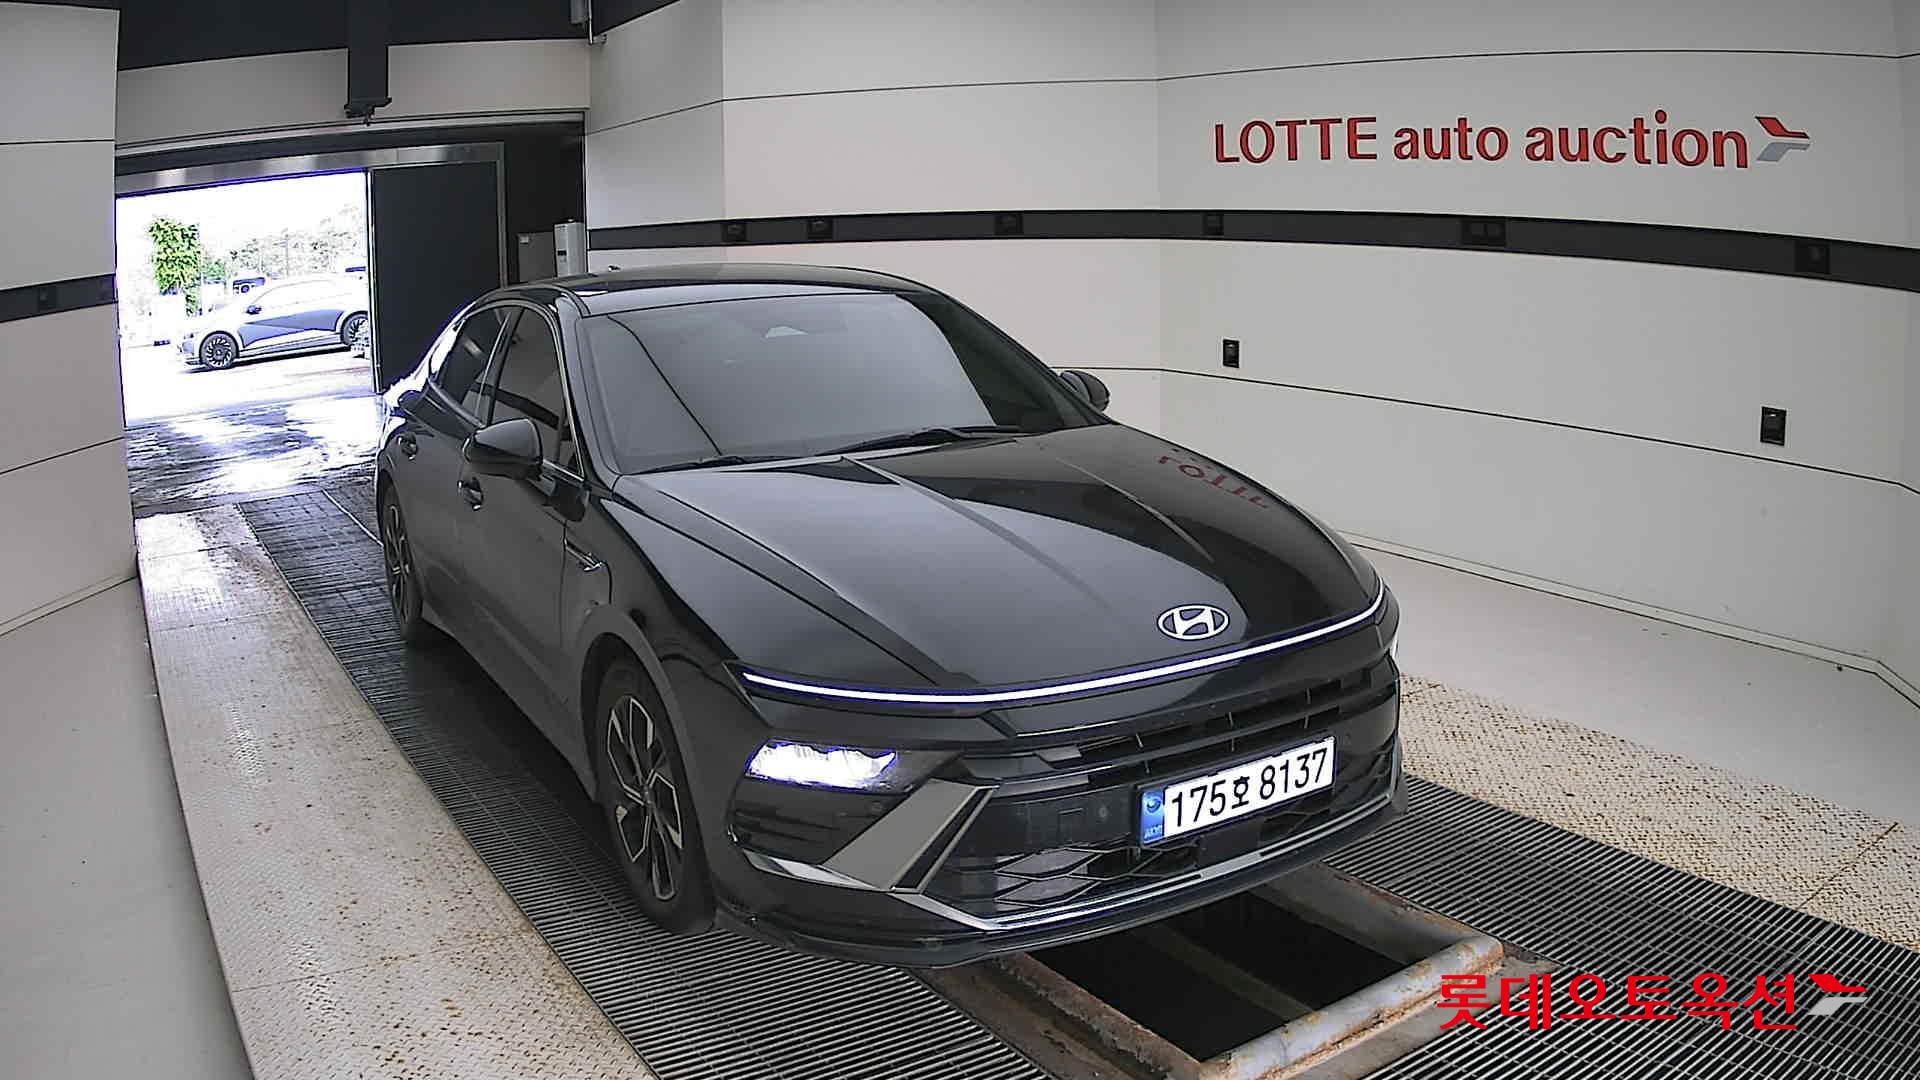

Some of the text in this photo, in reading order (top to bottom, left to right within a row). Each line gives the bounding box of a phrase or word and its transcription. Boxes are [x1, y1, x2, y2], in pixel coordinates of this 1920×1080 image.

[1213, 110, 1749, 169] LOTTE auto auction
[1171, 747, 1328, 827] 175호 8137
